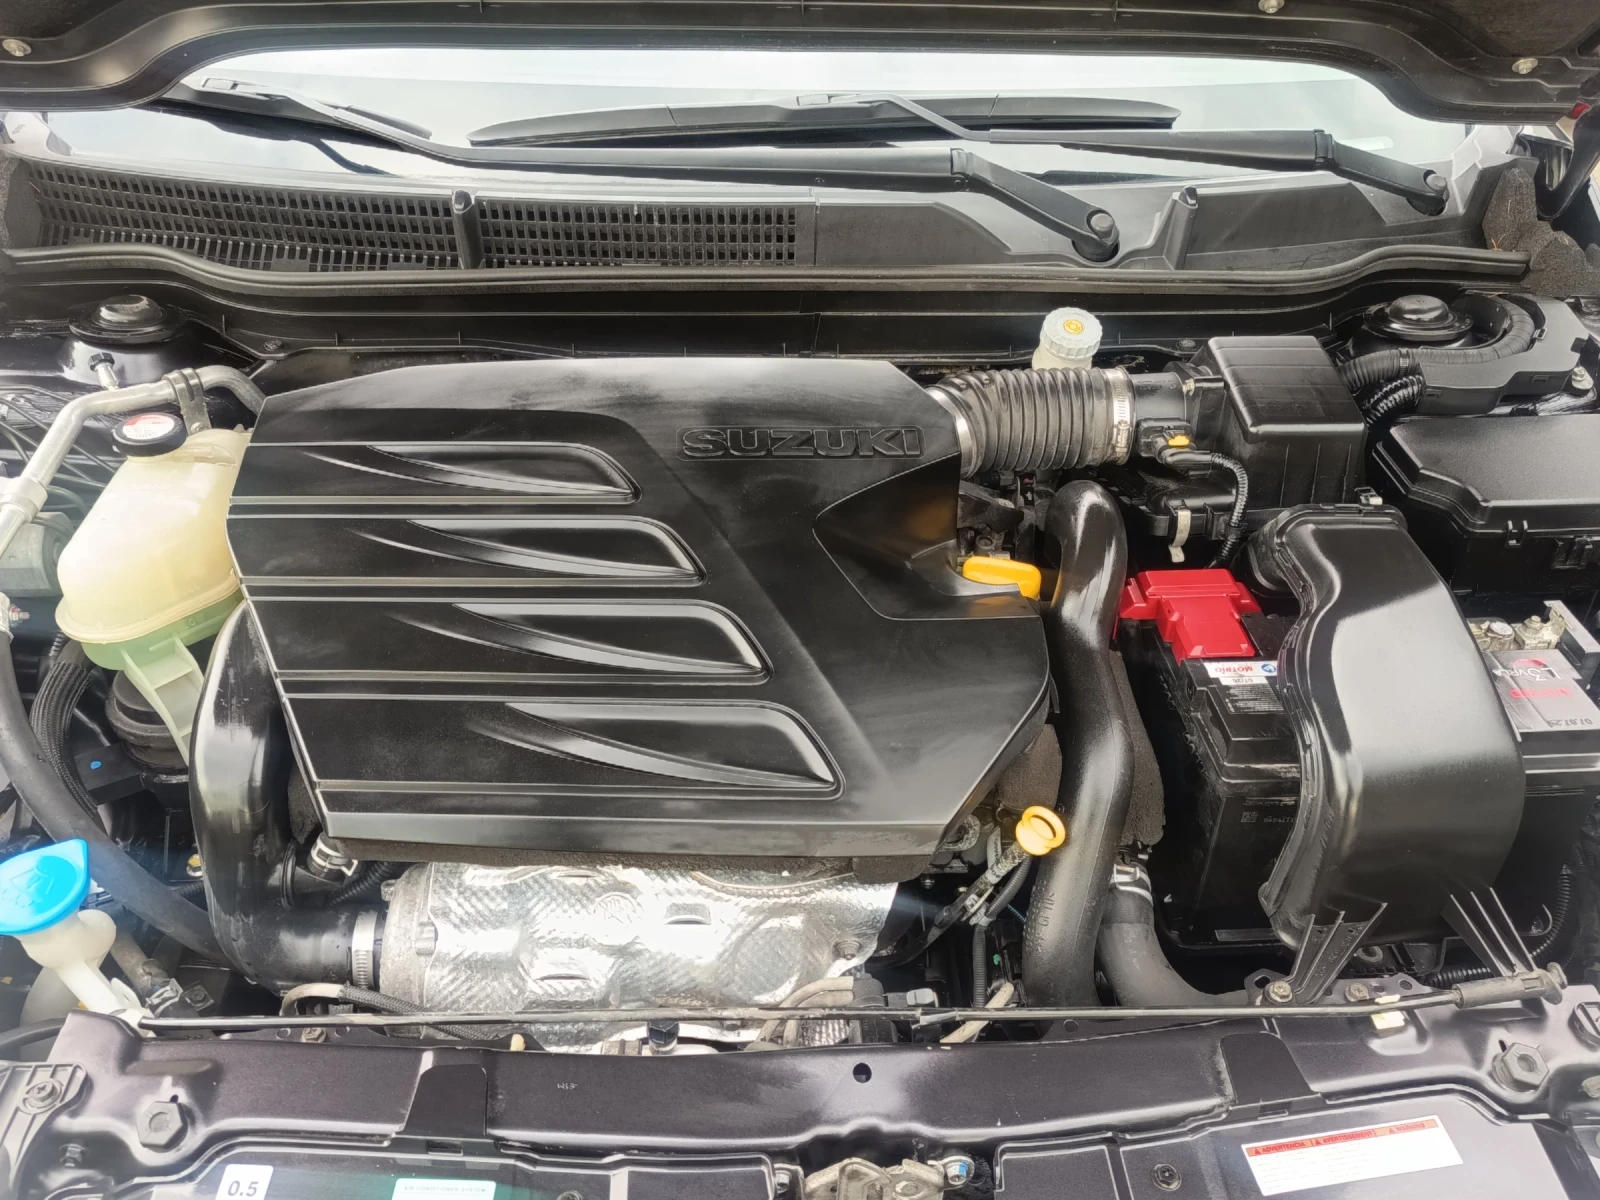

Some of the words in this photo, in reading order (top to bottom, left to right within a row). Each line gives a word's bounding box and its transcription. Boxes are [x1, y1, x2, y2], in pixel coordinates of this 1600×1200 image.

[683, 429, 921, 457] SUZUKI
[1396, 1122, 1425, 1132] WARNING
[1323, 1130, 1373, 1143] AVERTISSEMENT
[1262, 1141, 1306, 1154] ADVERTENCIA
[227, 1180, 259, 1197] 0.5
